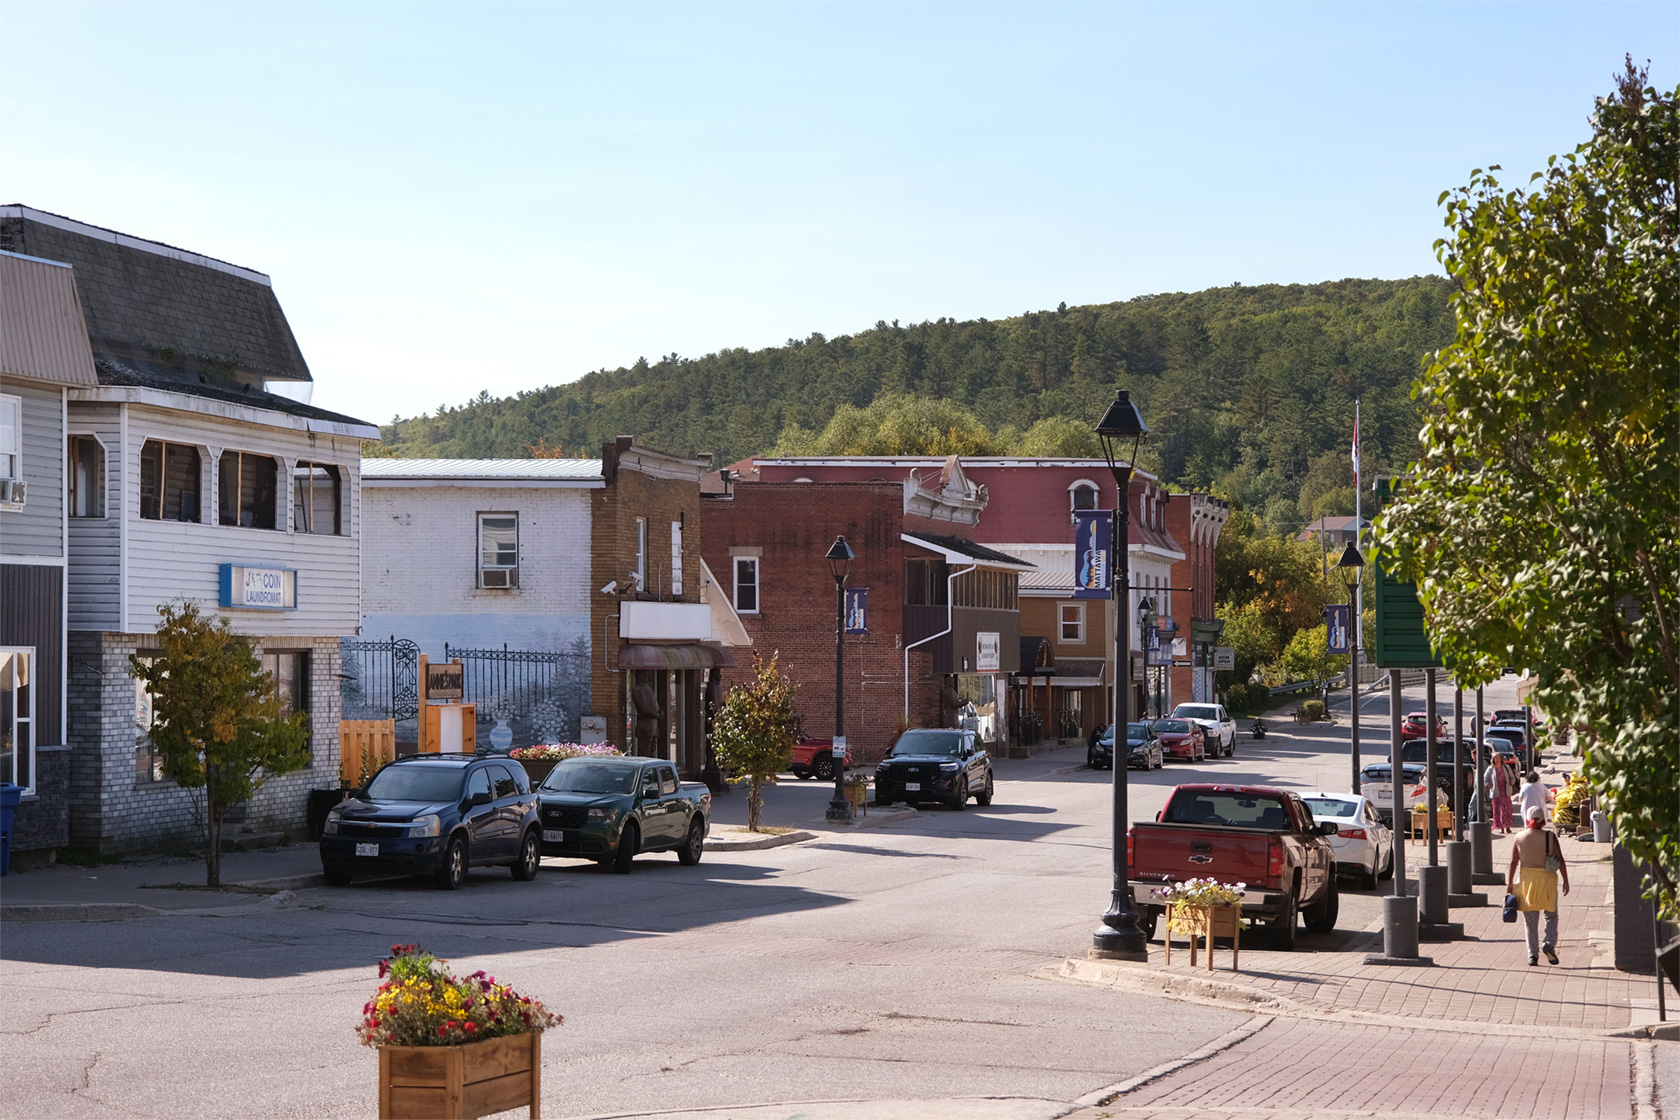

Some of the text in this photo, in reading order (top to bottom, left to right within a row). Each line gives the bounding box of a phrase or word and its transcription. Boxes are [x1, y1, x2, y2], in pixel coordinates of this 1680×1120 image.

[1094, 550, 1102, 588] MATTAWA
[263, 573, 281, 588] COIN
[246, 590, 282, 604] LAUNDROMAT
